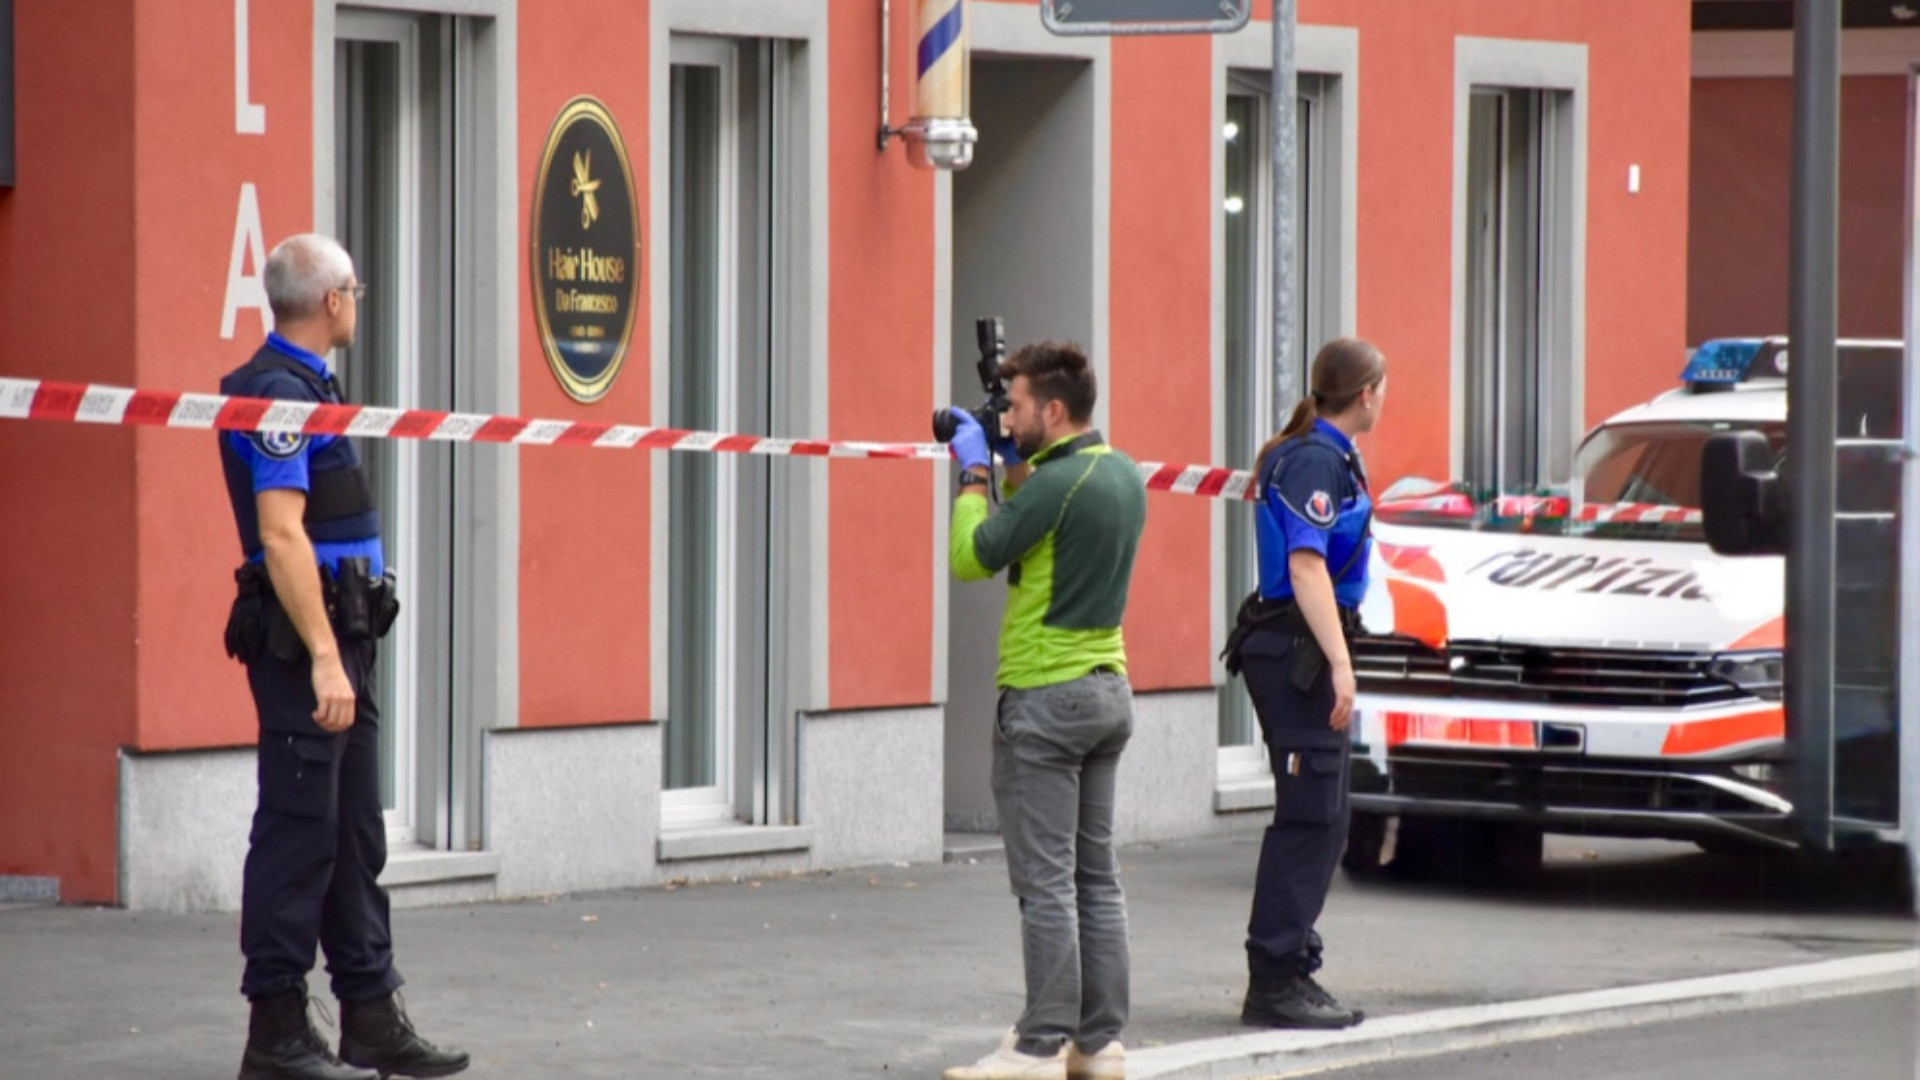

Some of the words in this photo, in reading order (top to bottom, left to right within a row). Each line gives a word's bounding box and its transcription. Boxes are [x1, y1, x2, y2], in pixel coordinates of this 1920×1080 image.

[548, 247, 579, 280] Hair
[580, 247, 625, 283] House
[570, 288, 618, 313] Francesco
